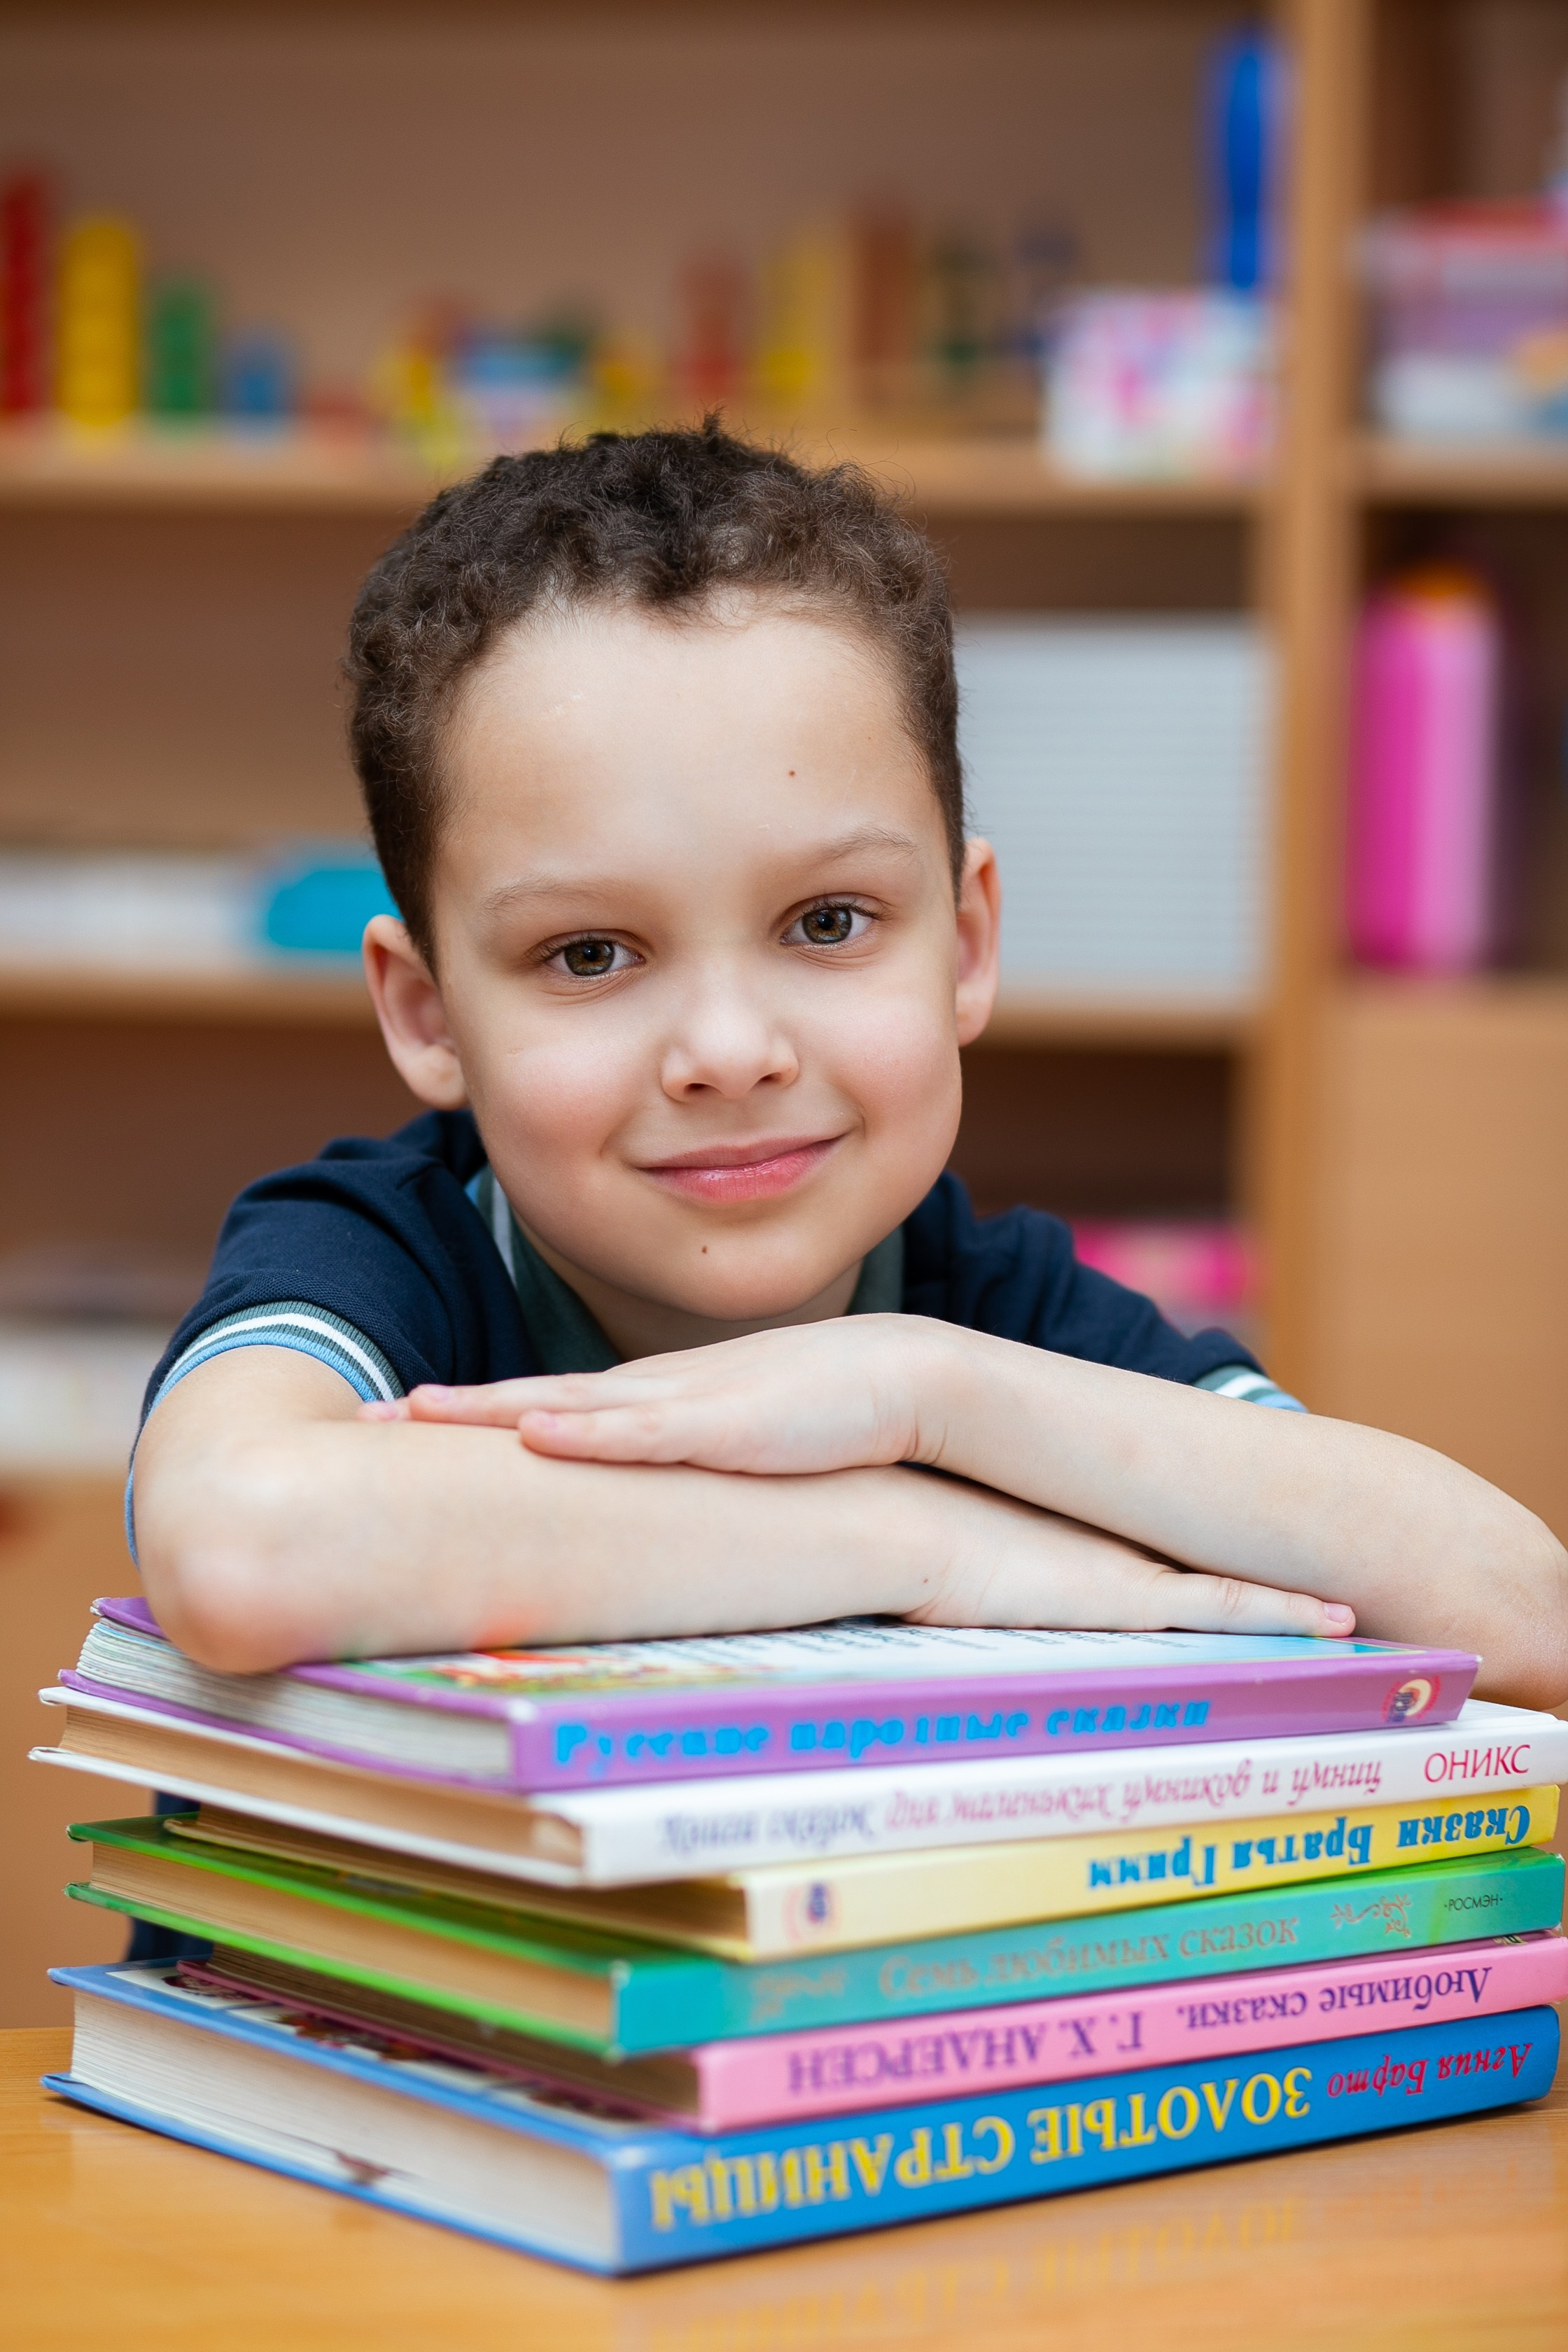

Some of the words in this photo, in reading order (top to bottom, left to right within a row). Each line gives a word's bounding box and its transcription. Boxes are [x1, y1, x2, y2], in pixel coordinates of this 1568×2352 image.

[1424, 1744, 1531, 1783] ОНИКС
[1121, 1758, 1253, 1823] умников
[1262, 1768, 1279, 1795] и
[1287, 1758, 1383, 1805] умниц
[1231, 1816, 1375, 1865] Братья
[1396, 1805, 1531, 1849] Сказки
[1087, 1835, 1217, 1889] Гримм
[1179, 1917, 1299, 1958] сказок
[1177, 1991, 1308, 2029] сказки.
[1319, 1967, 1492, 2012] Любимые
[787, 2022, 1046, 2095] АНДЕРСЕН
[1326, 2054, 1426, 2099] Барто
[1436, 2042, 1533, 2079] Агния
[1026, 2066, 1314, 2166] ЗОЛОТЫЕ
[650, 2115, 1016, 2231] СТРАНИЦЫ
